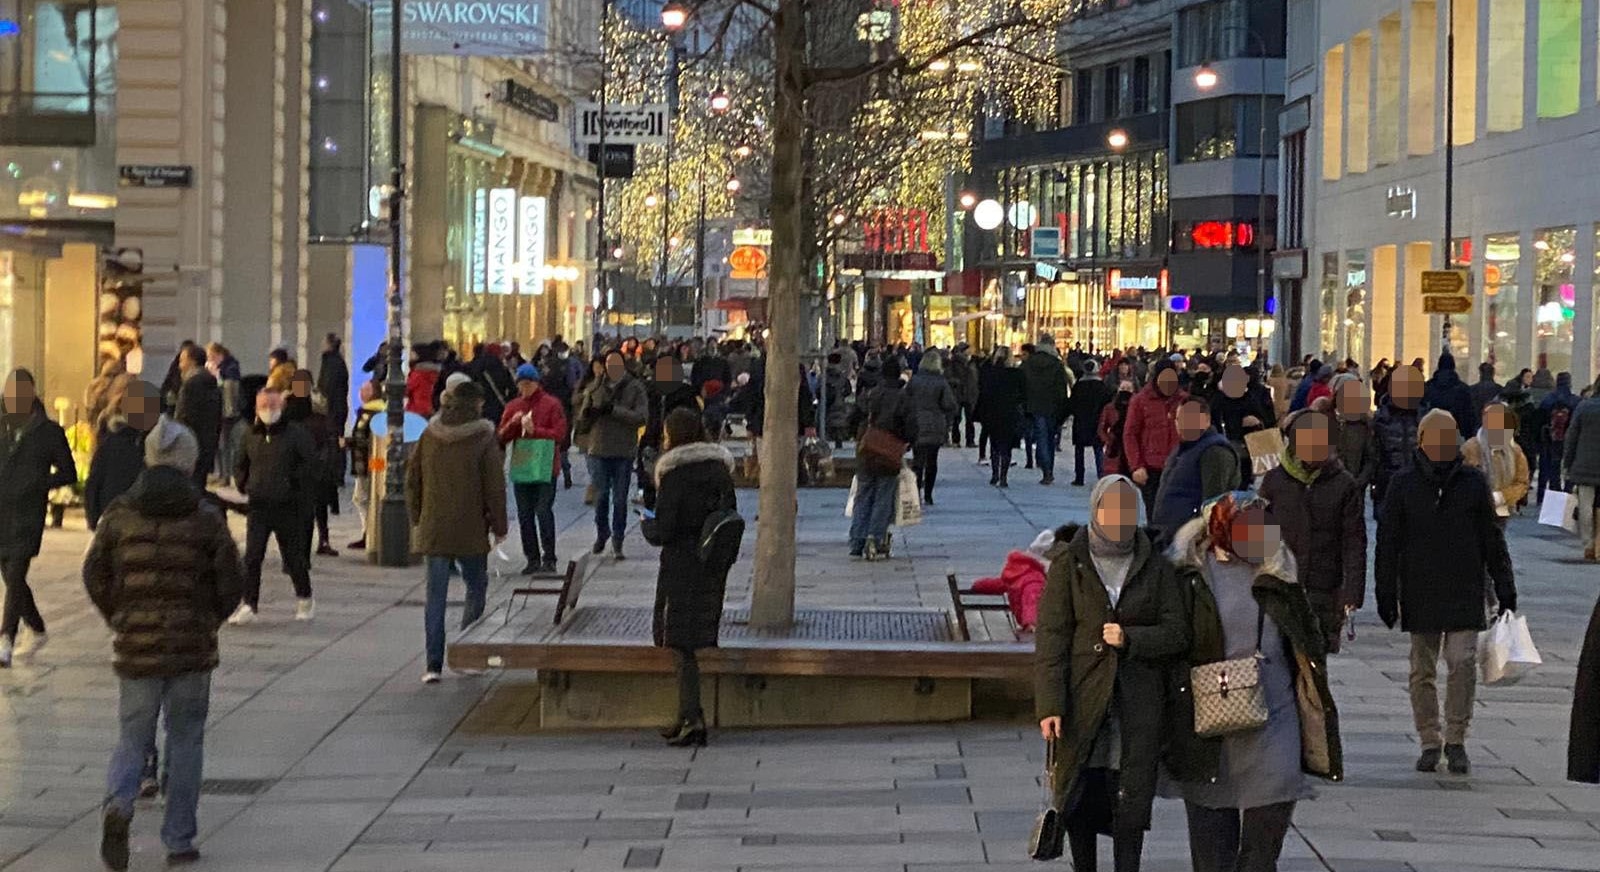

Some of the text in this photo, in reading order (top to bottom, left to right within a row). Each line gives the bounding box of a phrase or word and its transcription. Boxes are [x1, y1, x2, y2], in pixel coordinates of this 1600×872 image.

[403, 2, 539, 25] SWAROVSKI
[597, 117, 649, 130] Wolford
[494, 196, 508, 286] MANGO
[526, 204, 539, 287] MANGO
